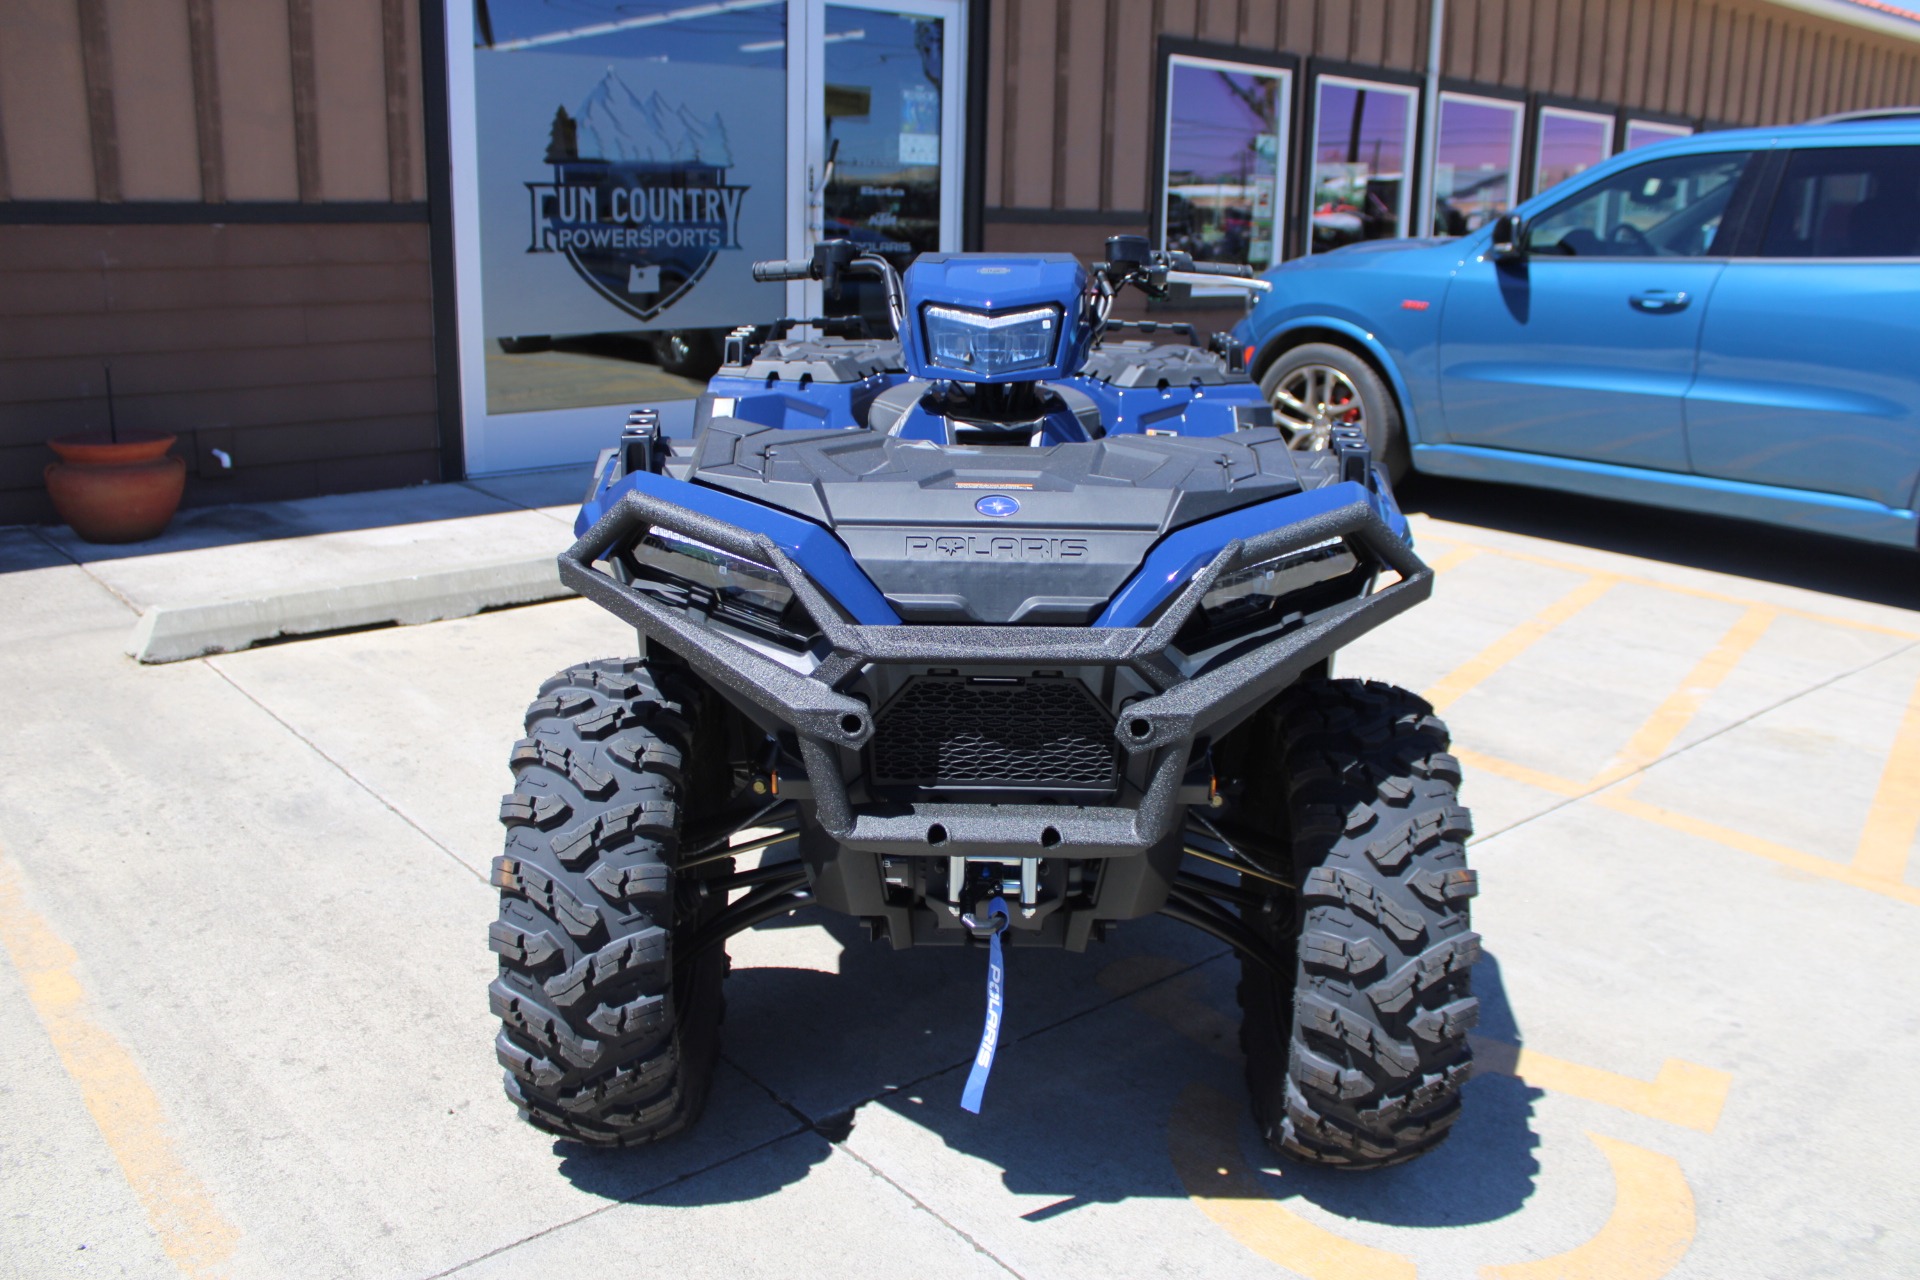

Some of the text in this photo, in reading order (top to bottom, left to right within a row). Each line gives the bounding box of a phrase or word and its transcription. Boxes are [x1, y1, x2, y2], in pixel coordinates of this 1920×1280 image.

[529, 184, 745, 251] FUN COUNTRY
[559, 227, 721, 249] POWERSPORTS
[905, 536, 1088, 559] POLARIS
[978, 964, 1001, 1068] POLARIS
